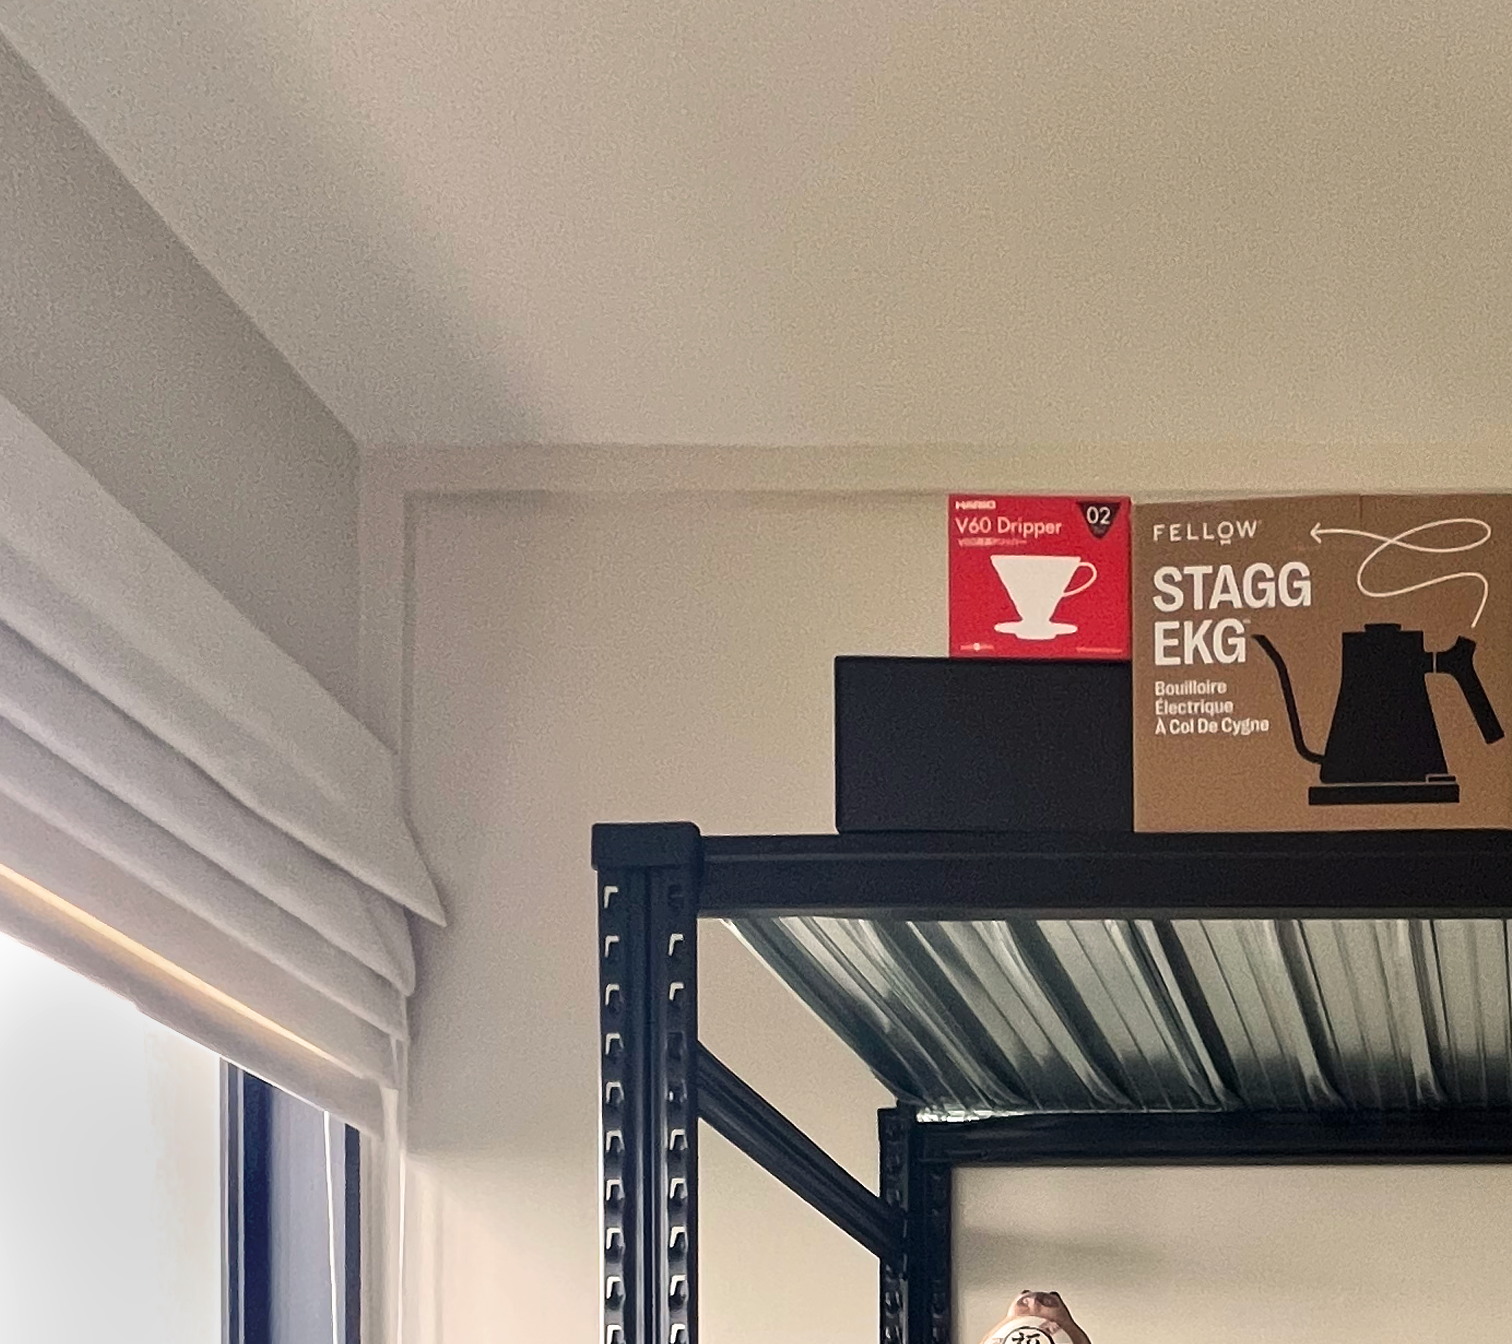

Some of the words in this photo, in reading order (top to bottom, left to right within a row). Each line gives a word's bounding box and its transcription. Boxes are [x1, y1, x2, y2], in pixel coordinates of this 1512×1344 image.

[1086, 506, 1111, 525] 02
[955, 517, 992, 534] V60
[997, 516, 1063, 539] Dripper
[1152, 520, 1258, 546] FELLOW
[1152, 561, 1312, 612] STAGG
[1153, 618, 1247, 666] EKG
[1155, 680, 1228, 696] Bouilloire
[1155, 698, 1234, 717] Électrique
[1155, 717, 1167, 735] À
[1169, 718, 1195, 735] Col
[1197, 717, 1219, 734] De
[1221, 716, 1270, 736] Cygne
